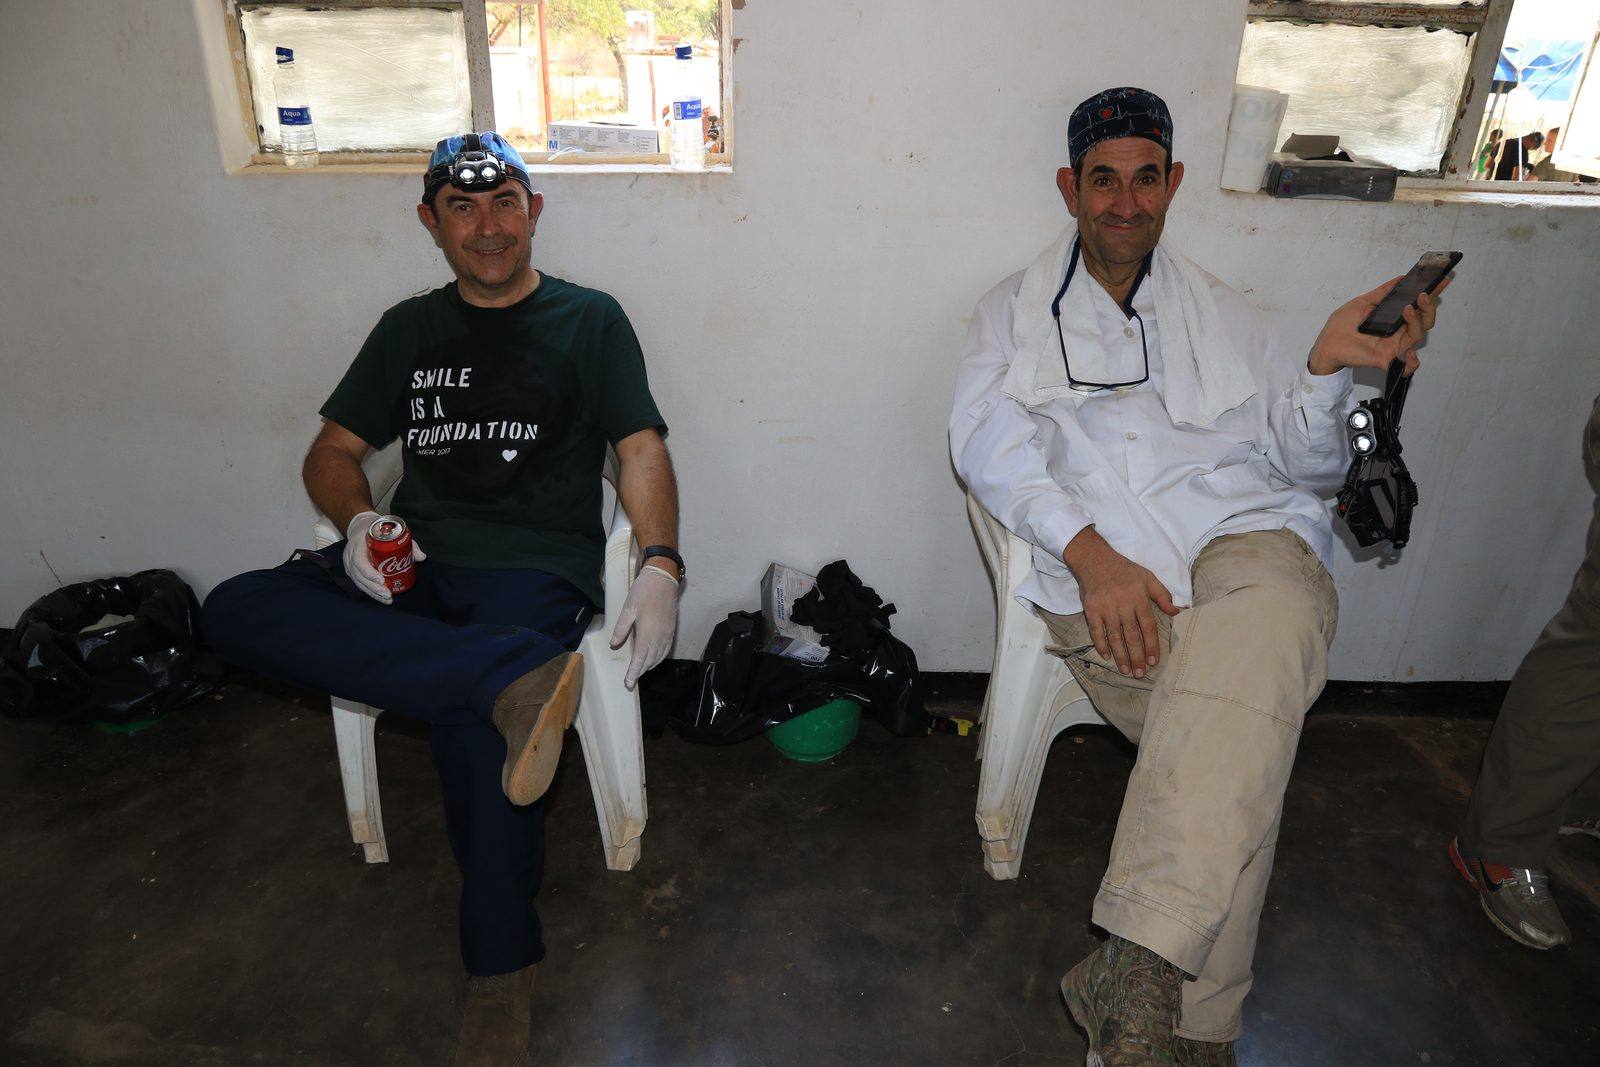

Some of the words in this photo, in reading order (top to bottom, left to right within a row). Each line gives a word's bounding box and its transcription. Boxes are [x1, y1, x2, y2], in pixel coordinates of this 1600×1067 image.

[549, 140, 558, 150] M
[411, 367, 472, 389] SMILE
[411, 397, 426, 420] IS
[433, 396, 445, 418] A
[407, 421, 538, 449] FOUNDATION
